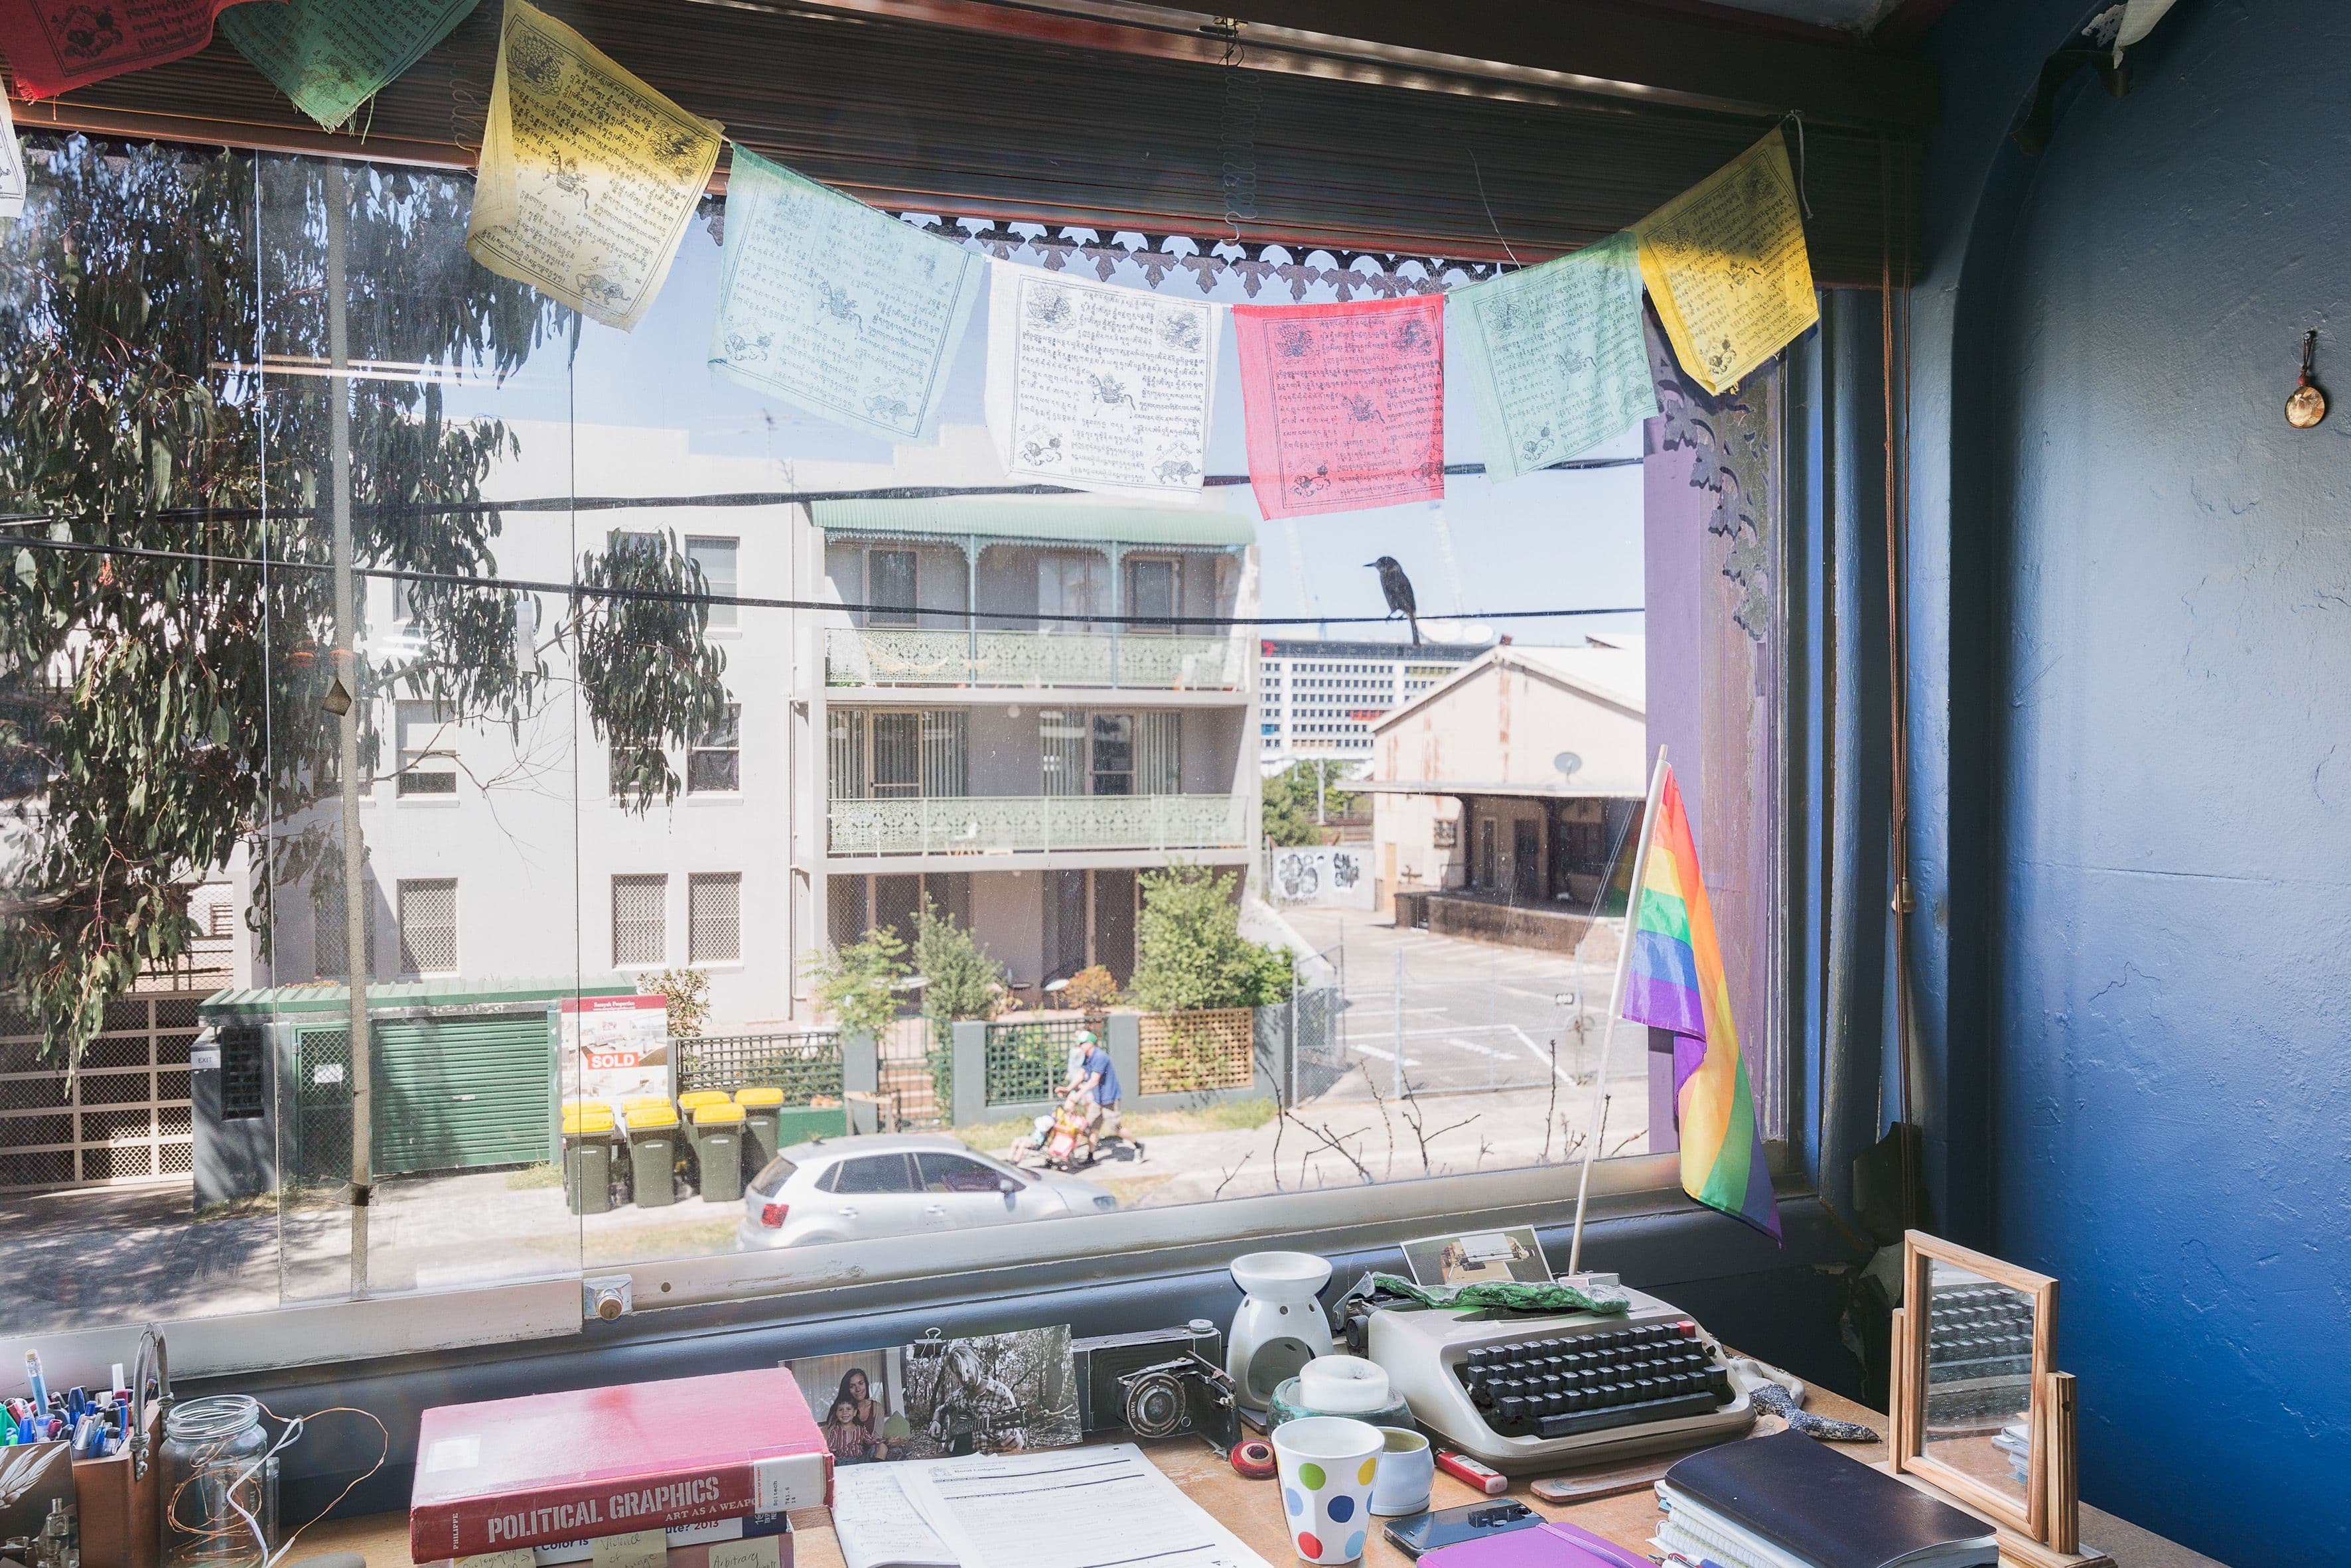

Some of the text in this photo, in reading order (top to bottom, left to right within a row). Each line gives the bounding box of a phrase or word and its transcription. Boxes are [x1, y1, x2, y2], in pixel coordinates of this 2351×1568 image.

[591, 1054, 635, 1068] SOLD
[488, 1476, 720, 1543] POLITICAL GRAPHICS
[665, 1498, 756, 1522] ART AS A WEAPO
